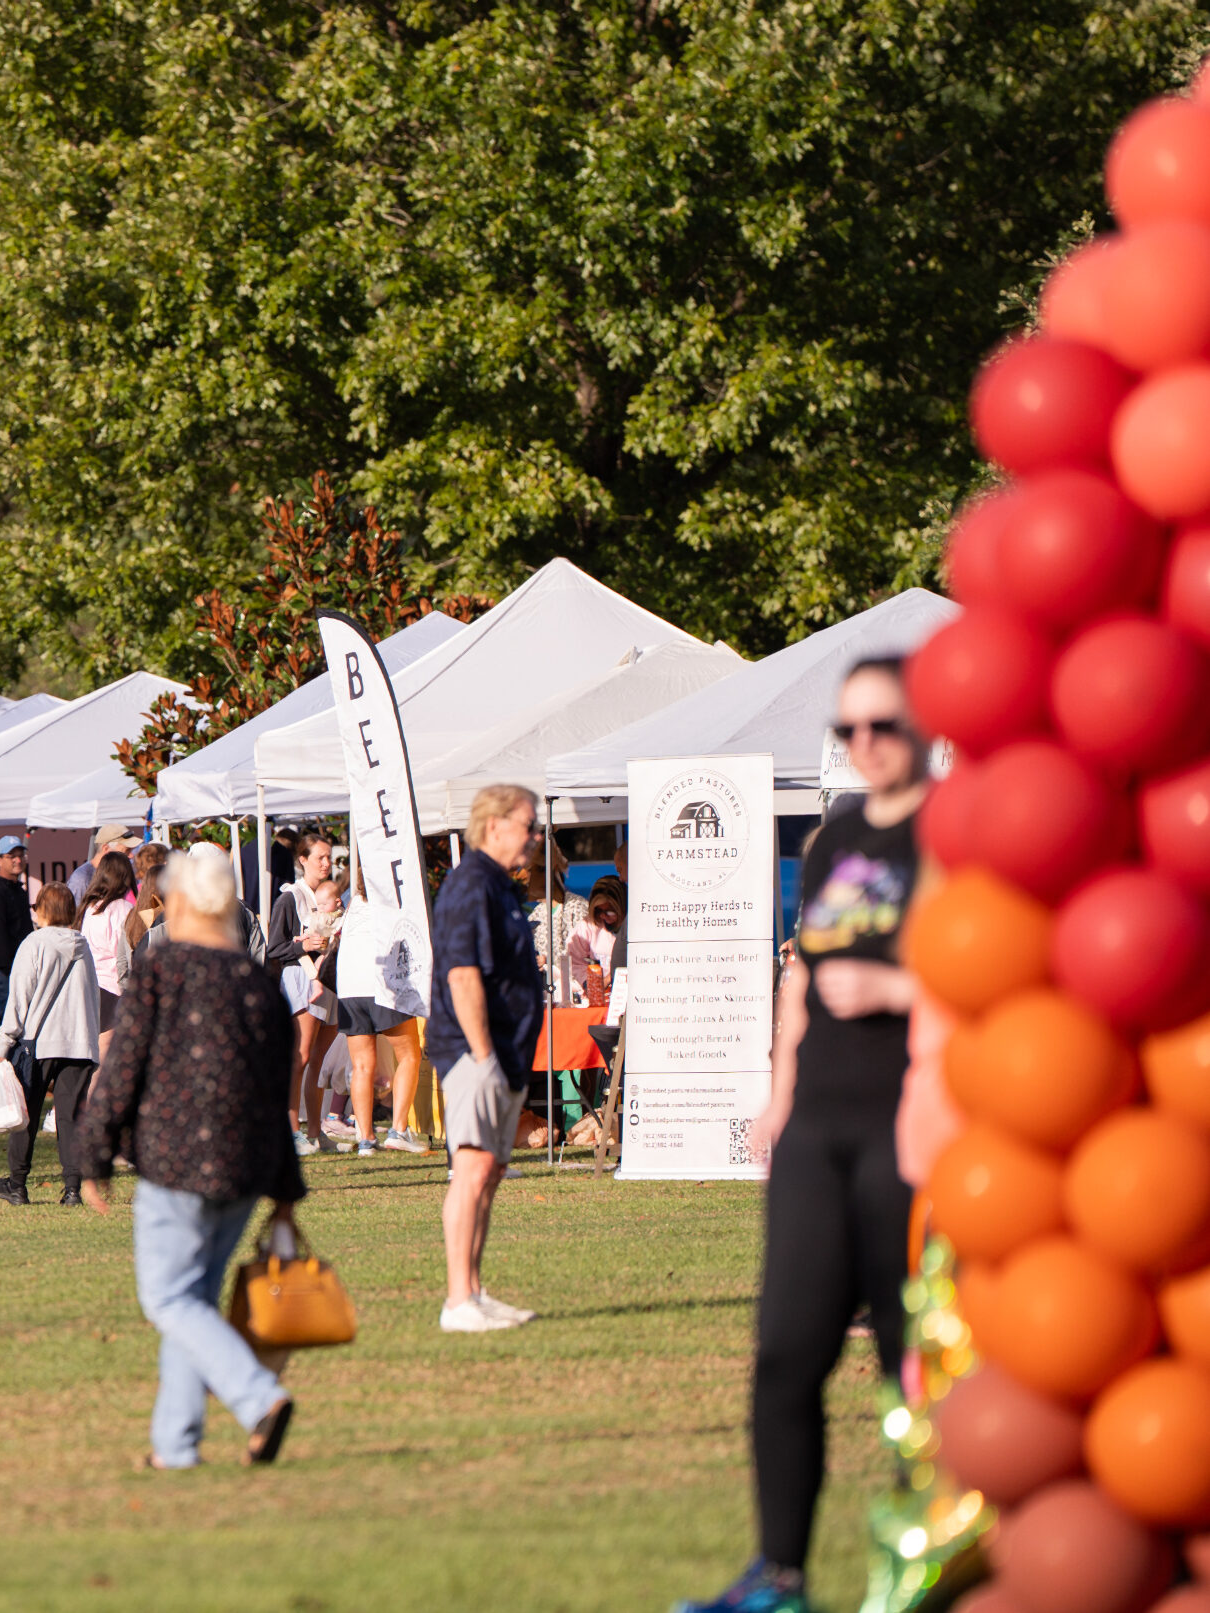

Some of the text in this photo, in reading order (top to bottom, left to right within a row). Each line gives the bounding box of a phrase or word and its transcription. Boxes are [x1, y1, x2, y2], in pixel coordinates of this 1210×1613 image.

[345, 651, 404, 909] BEEF
[654, 776, 742, 820] BLENDED PASTURES
[657, 847, 738, 860] FARMSTEAD
[640, 900, 753, 914] From Happy Herds to
[656, 917, 738, 929] Healthy Homes
[635, 955, 659, 964] Local
[738, 953, 759, 962] Beef
[716, 974, 737, 985] Eggs
[634, 993, 766, 1005] Nourishing Tallow Skincare
[635, 1013, 757, 1024] Homemade Jams & Jellies
[650, 1034, 741, 1045] Sourdough Bread &
[667, 1050, 727, 1059] Baked Goods
